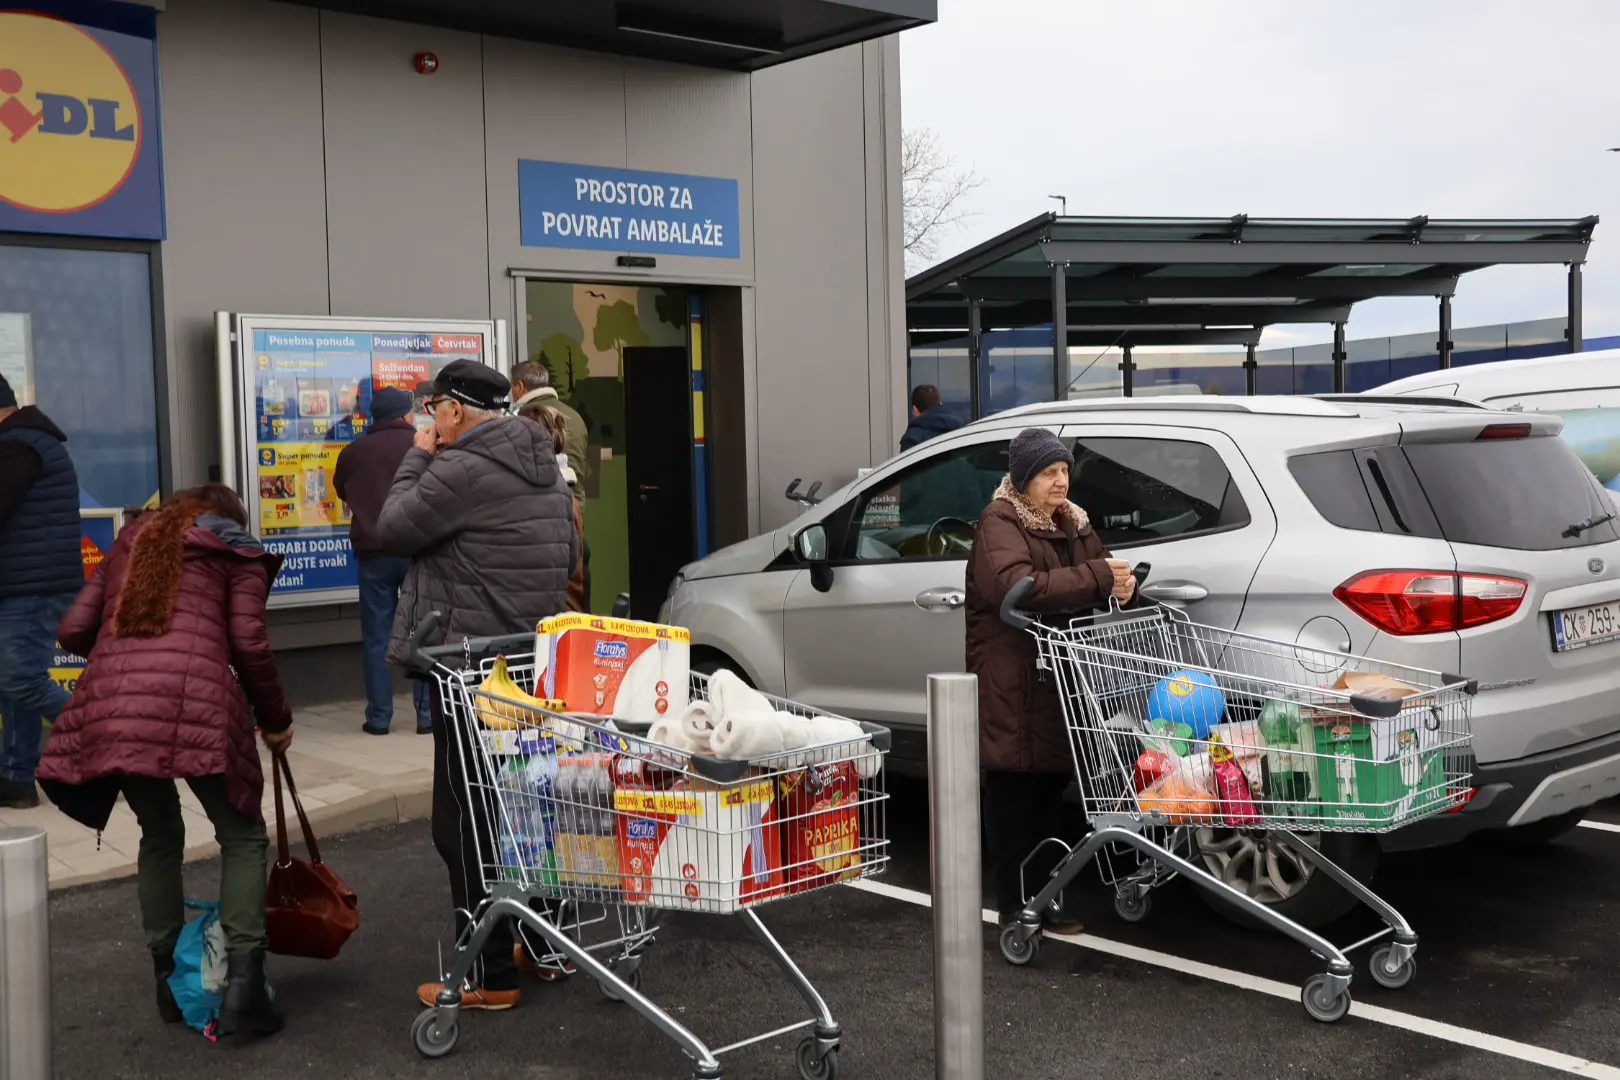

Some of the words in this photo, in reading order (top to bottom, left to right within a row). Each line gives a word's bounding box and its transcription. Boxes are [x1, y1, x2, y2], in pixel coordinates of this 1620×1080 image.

[575, 178, 664, 208] PROSTOR
[670, 187, 693, 210] ZA
[542, 211, 622, 240] POVRAT
[627, 218, 723, 246] AMBALAŽE
[269, 335, 314, 346] Posebna
[316, 336, 355, 348] ponuda
[374, 336, 431, 349] Ponedjeljak
[438, 337, 476, 349] Četvrtak
[300, 452, 330, 461] ponuda!
[281, 557, 317, 570] PUSTE
[319, 554, 347, 568] svaki
[273, 574, 304, 587] edan!
[1564, 613, 1580, 640] CK
[1588, 605, 1620, 635] 259-
[596, 641, 626, 658] Floralys
[54, 653, 87, 666] godin
[805, 816, 858, 846] PAPRIKA
